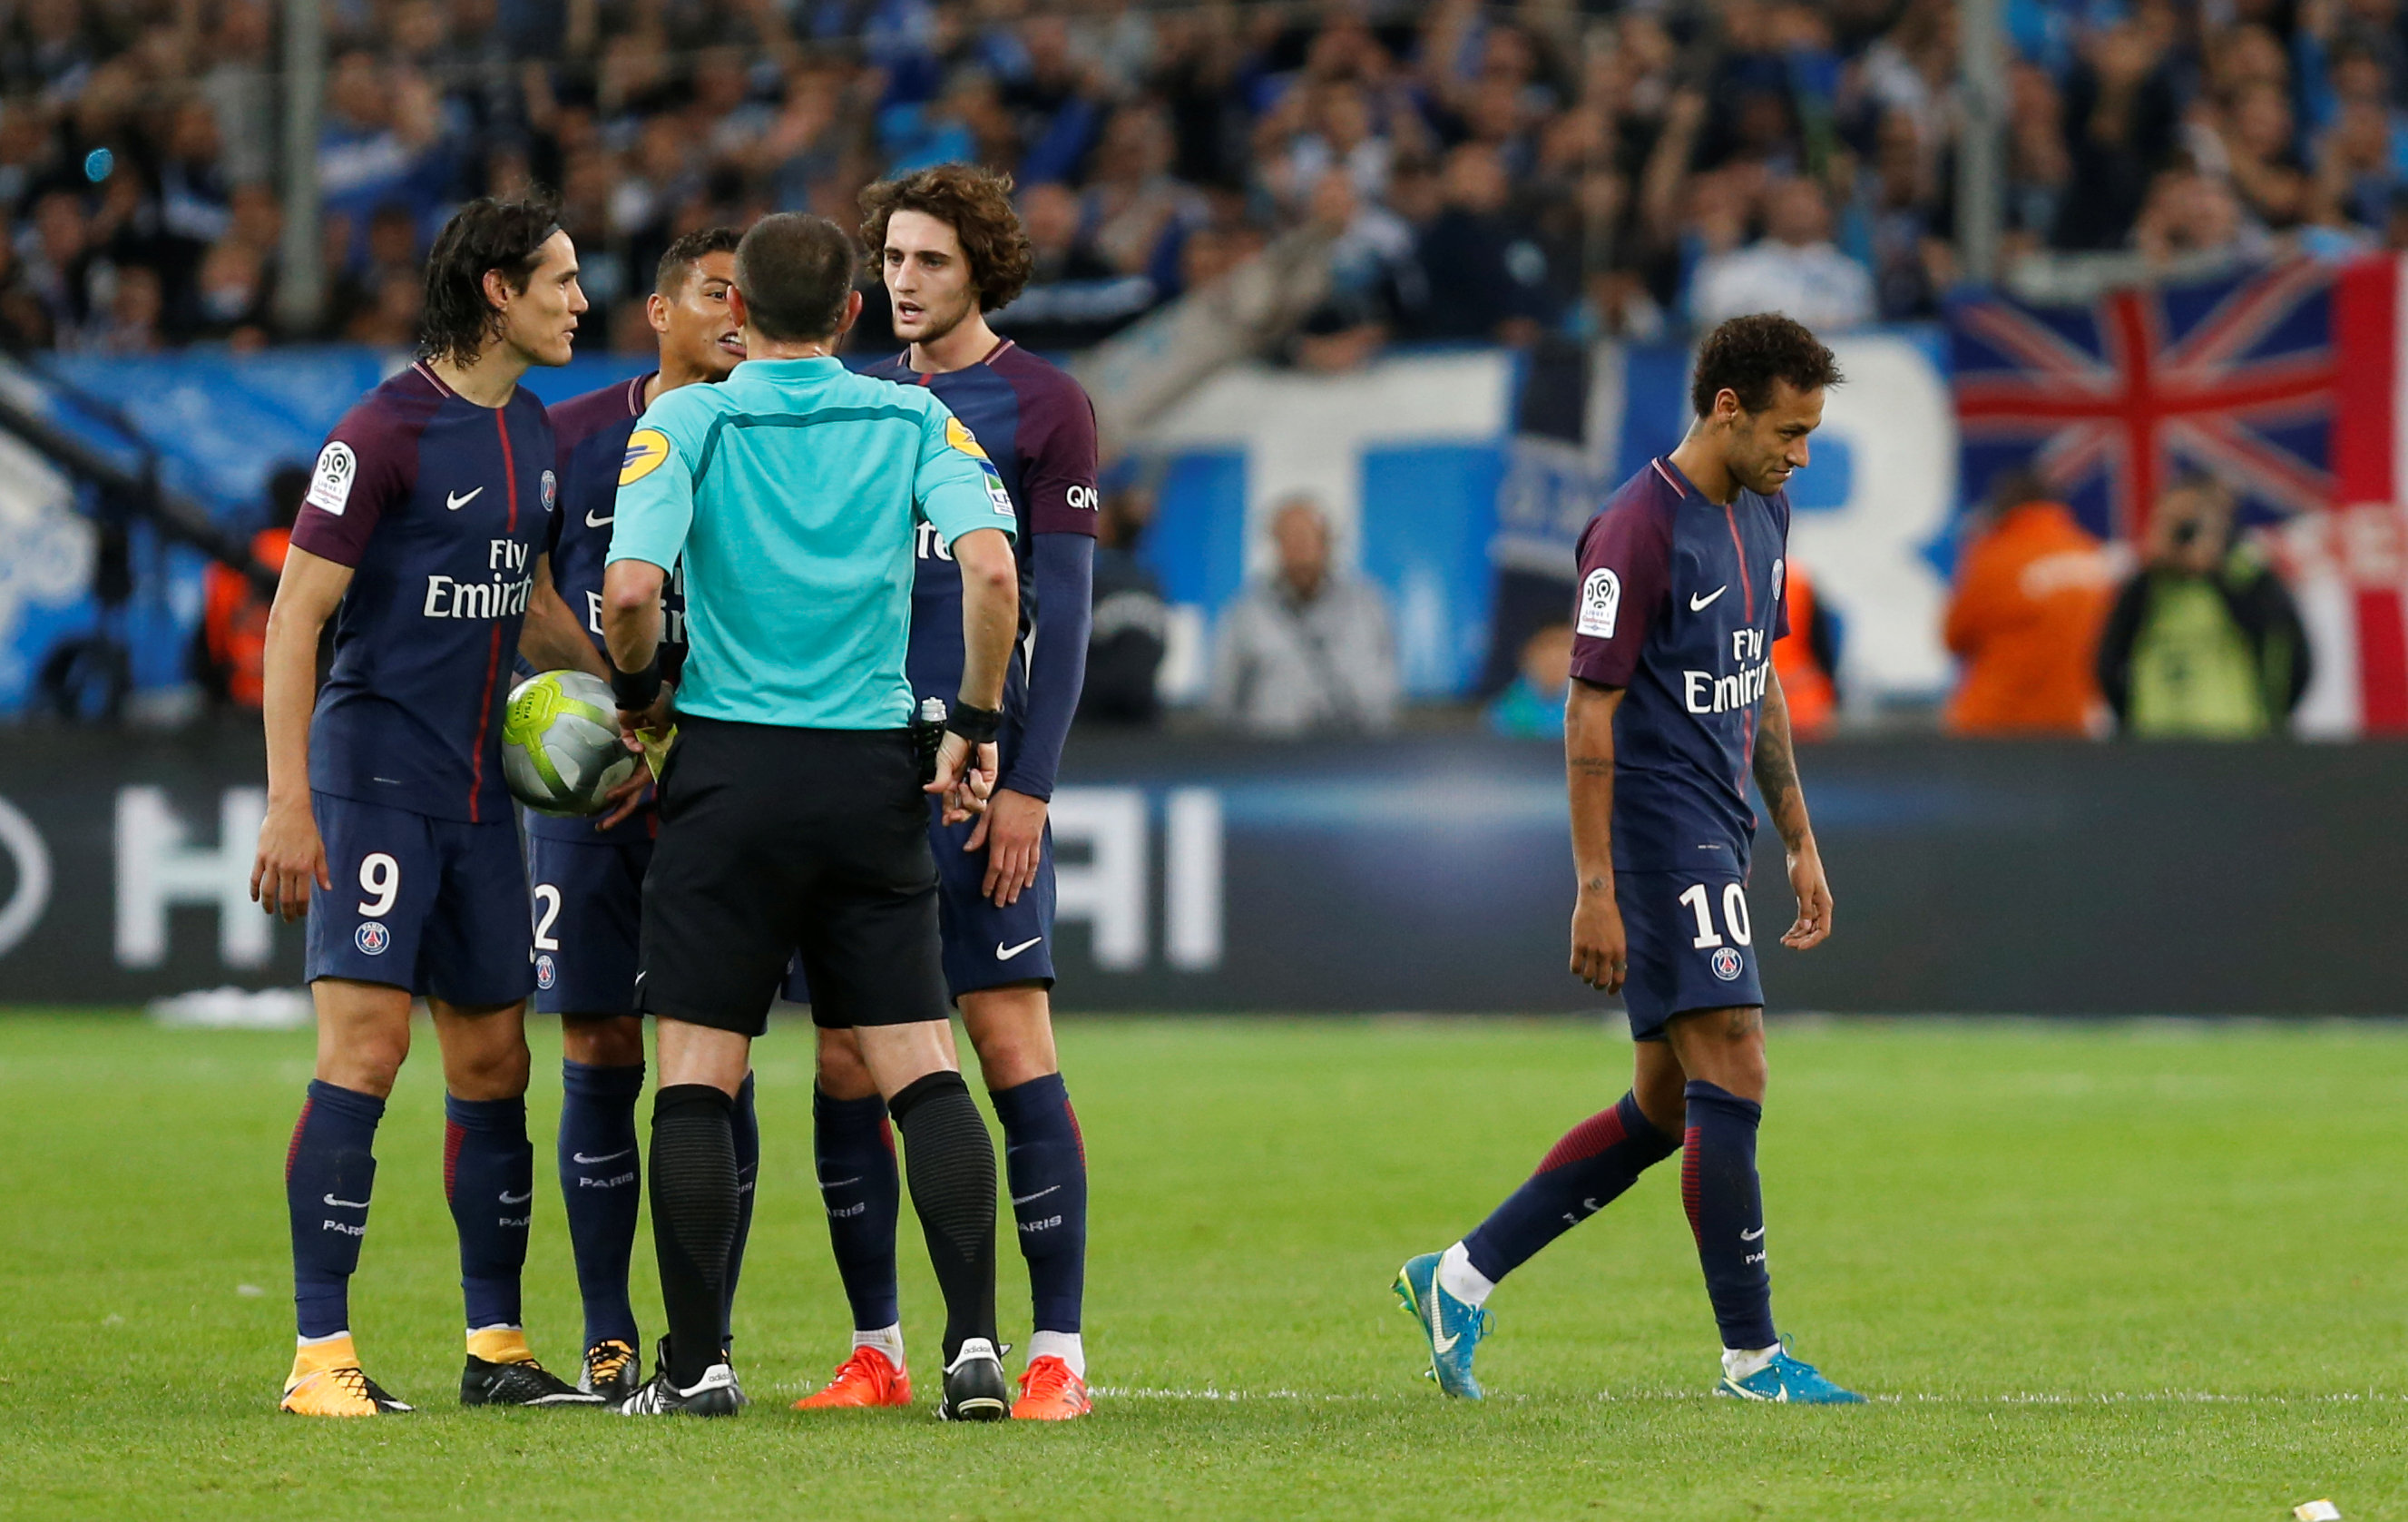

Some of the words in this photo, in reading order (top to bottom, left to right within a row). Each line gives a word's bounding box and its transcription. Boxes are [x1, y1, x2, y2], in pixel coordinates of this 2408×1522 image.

[1066, 485, 1099, 512] QN
[489, 538, 529, 574] Fly
[1732, 627, 1765, 662] Fly
[357, 852, 400, 918] 9
[533, 883, 562, 951] 2
[1679, 881, 1752, 949] 10
[579, 1172, 634, 1188] PARIS
